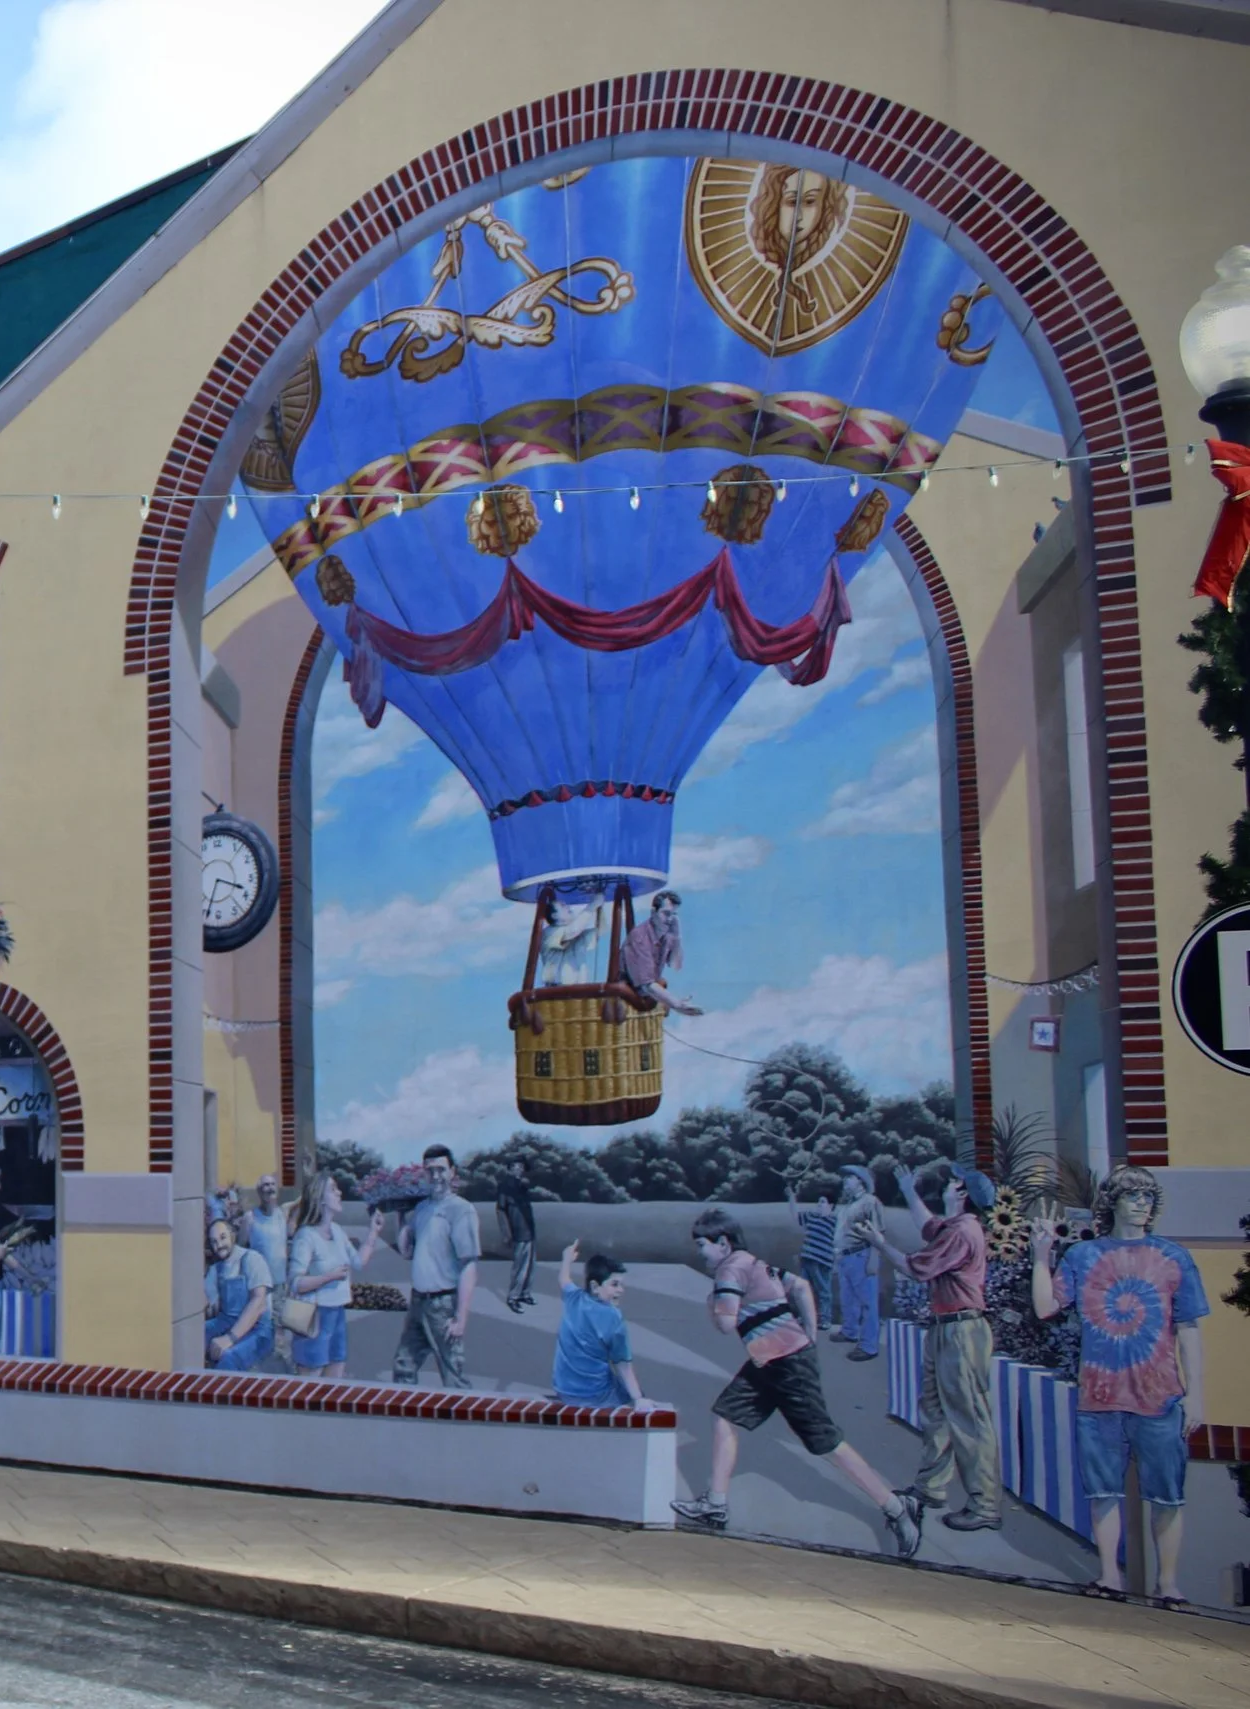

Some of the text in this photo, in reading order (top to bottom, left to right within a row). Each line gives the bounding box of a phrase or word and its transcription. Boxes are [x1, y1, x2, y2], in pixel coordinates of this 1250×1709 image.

[213, 839, 222, 848] 12
[243, 890, 249, 901] 4
[215, 910, 222, 920] 6
[231, 905, 238, 916] 5
